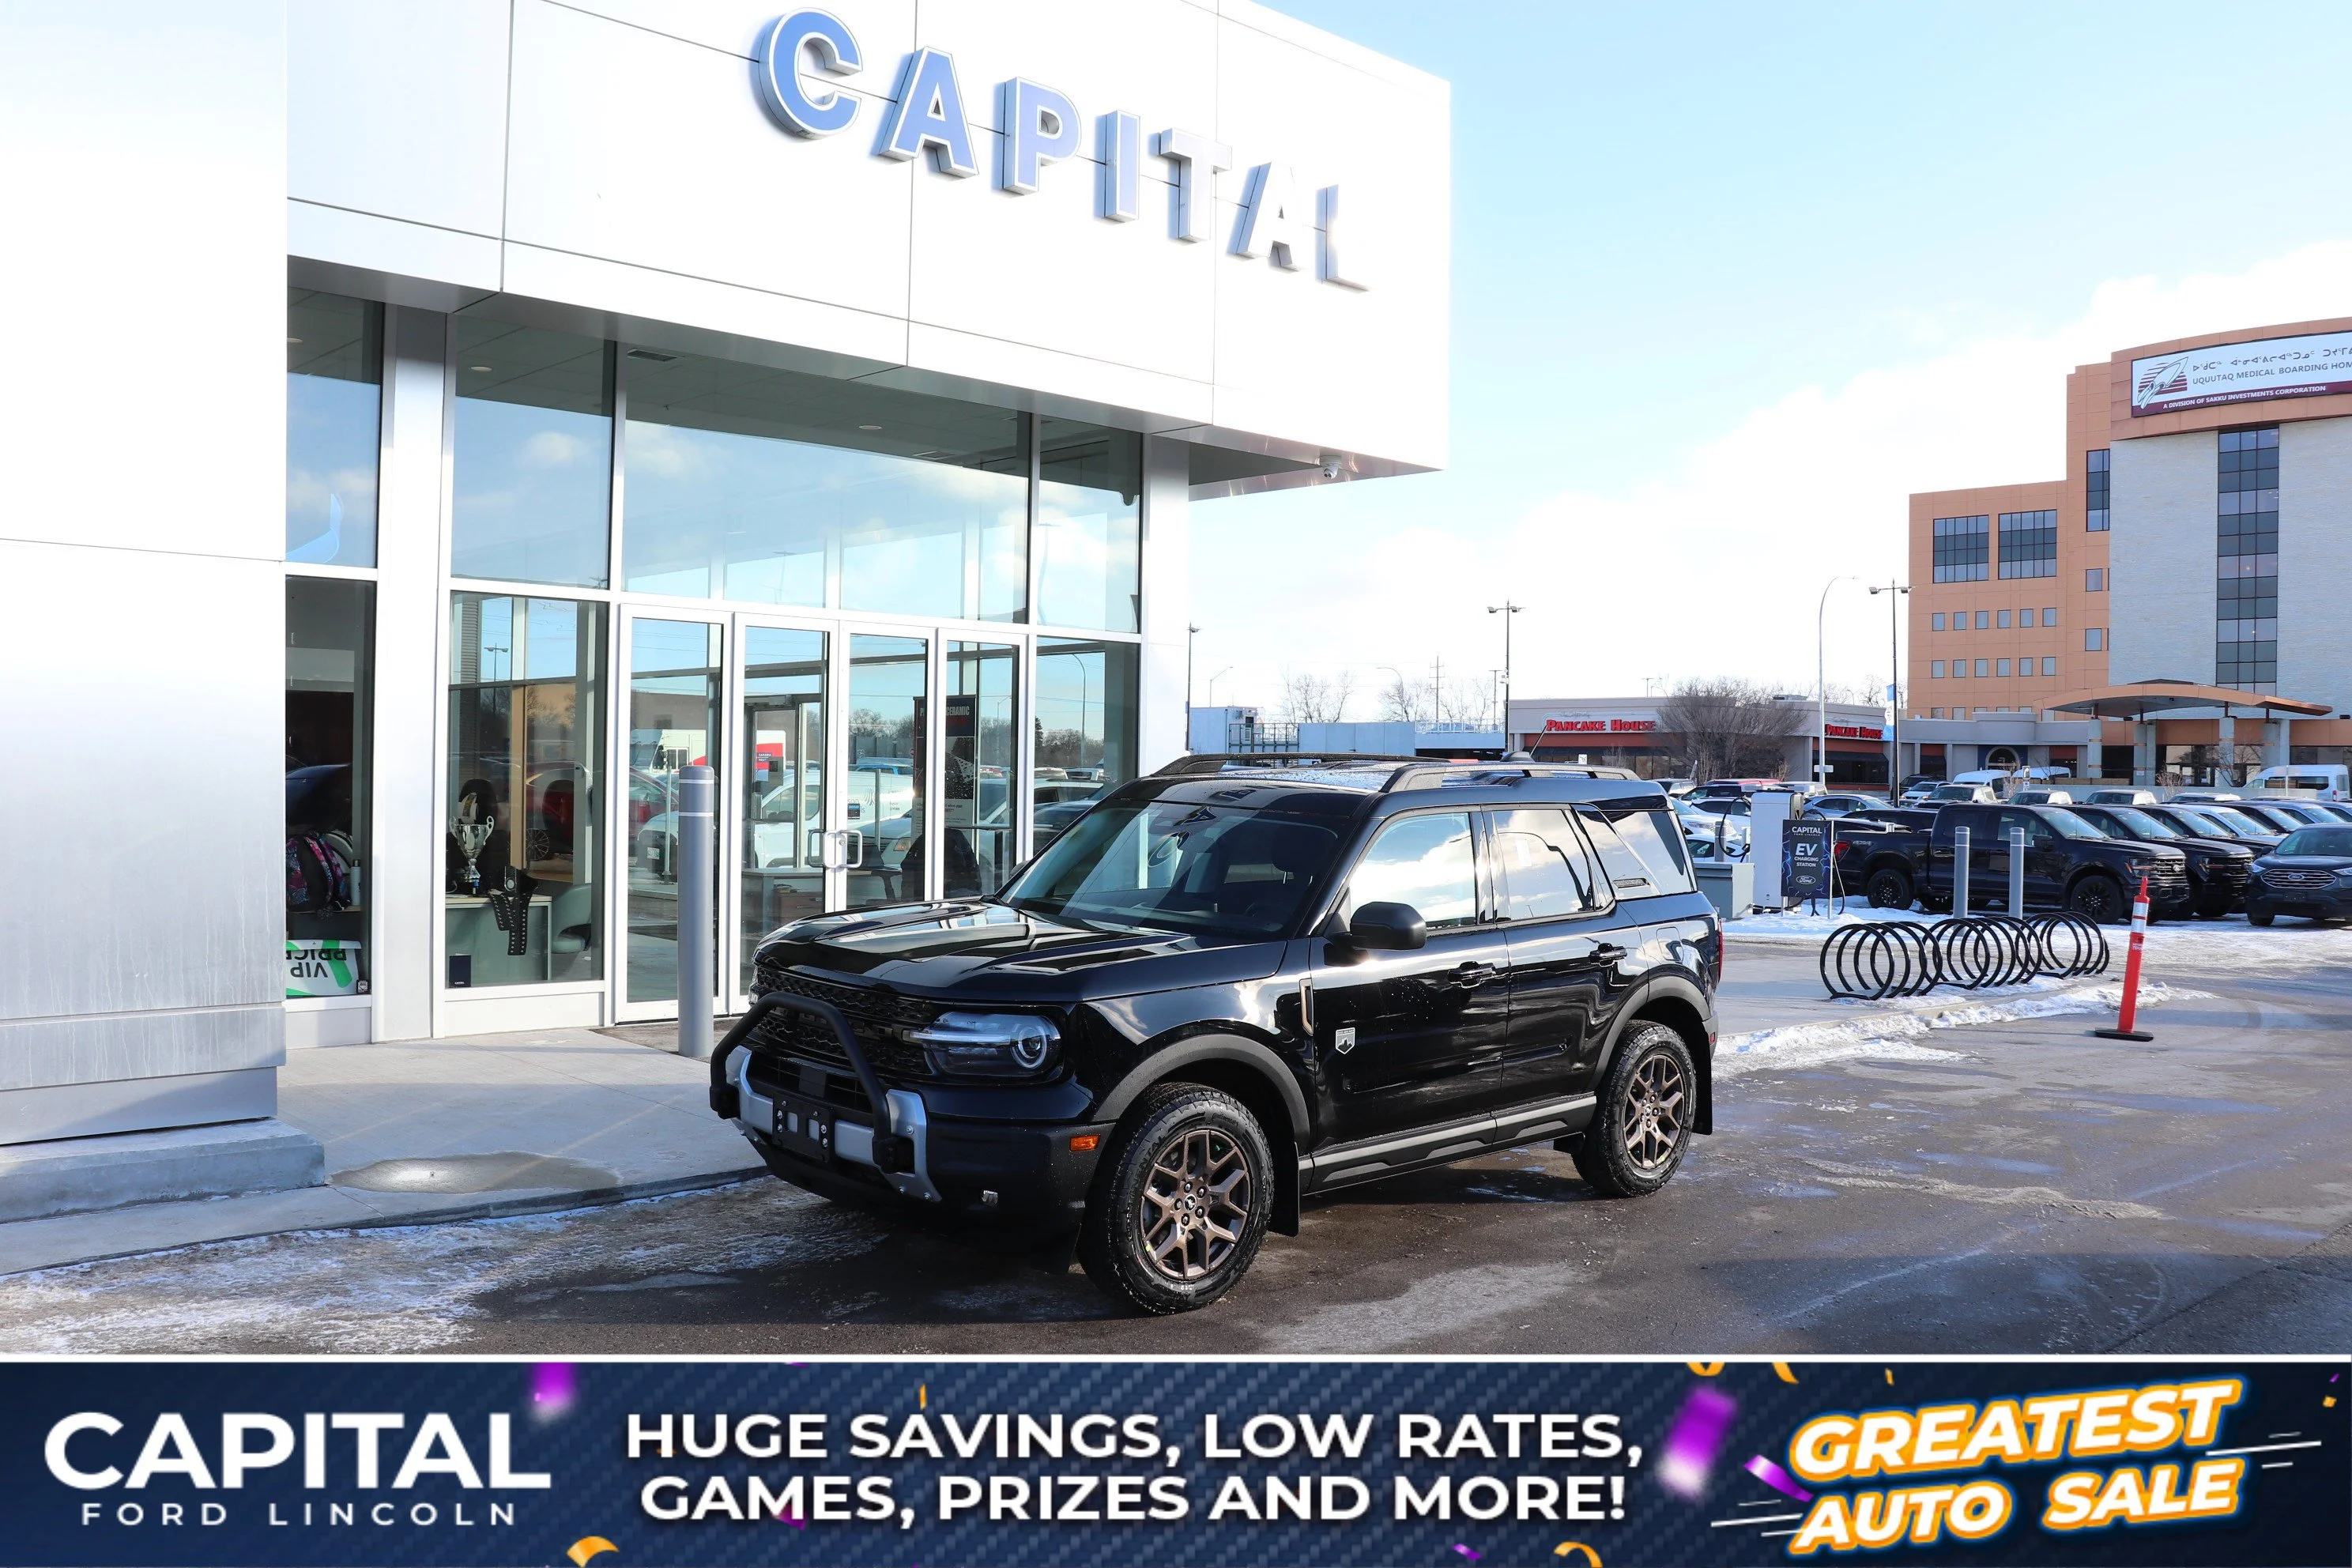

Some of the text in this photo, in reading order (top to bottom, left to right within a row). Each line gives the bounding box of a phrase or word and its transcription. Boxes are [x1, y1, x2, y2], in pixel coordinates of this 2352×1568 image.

[759, 6, 1370, 292] CAPITAL
[2192, 373, 2234, 385] UQUUTAQ
[2236, 369, 2275, 379] MEDICAL
[2278, 364, 2328, 375] BOARDING
[2169, 400, 2196, 409] DIVISION
[2228, 390, 2274, 400] INVESTMENTS
[2275, 386, 2327, 395] CORPORATION
[946, 706, 970, 716] CERAMIC
[1547, 719, 1656, 732] PANCAKE HOUSE
[1825, 724, 1884, 740] PANCAKE HOUSE
[1795, 842, 1818, 856] EV
[290, 962, 328, 978] VIP
